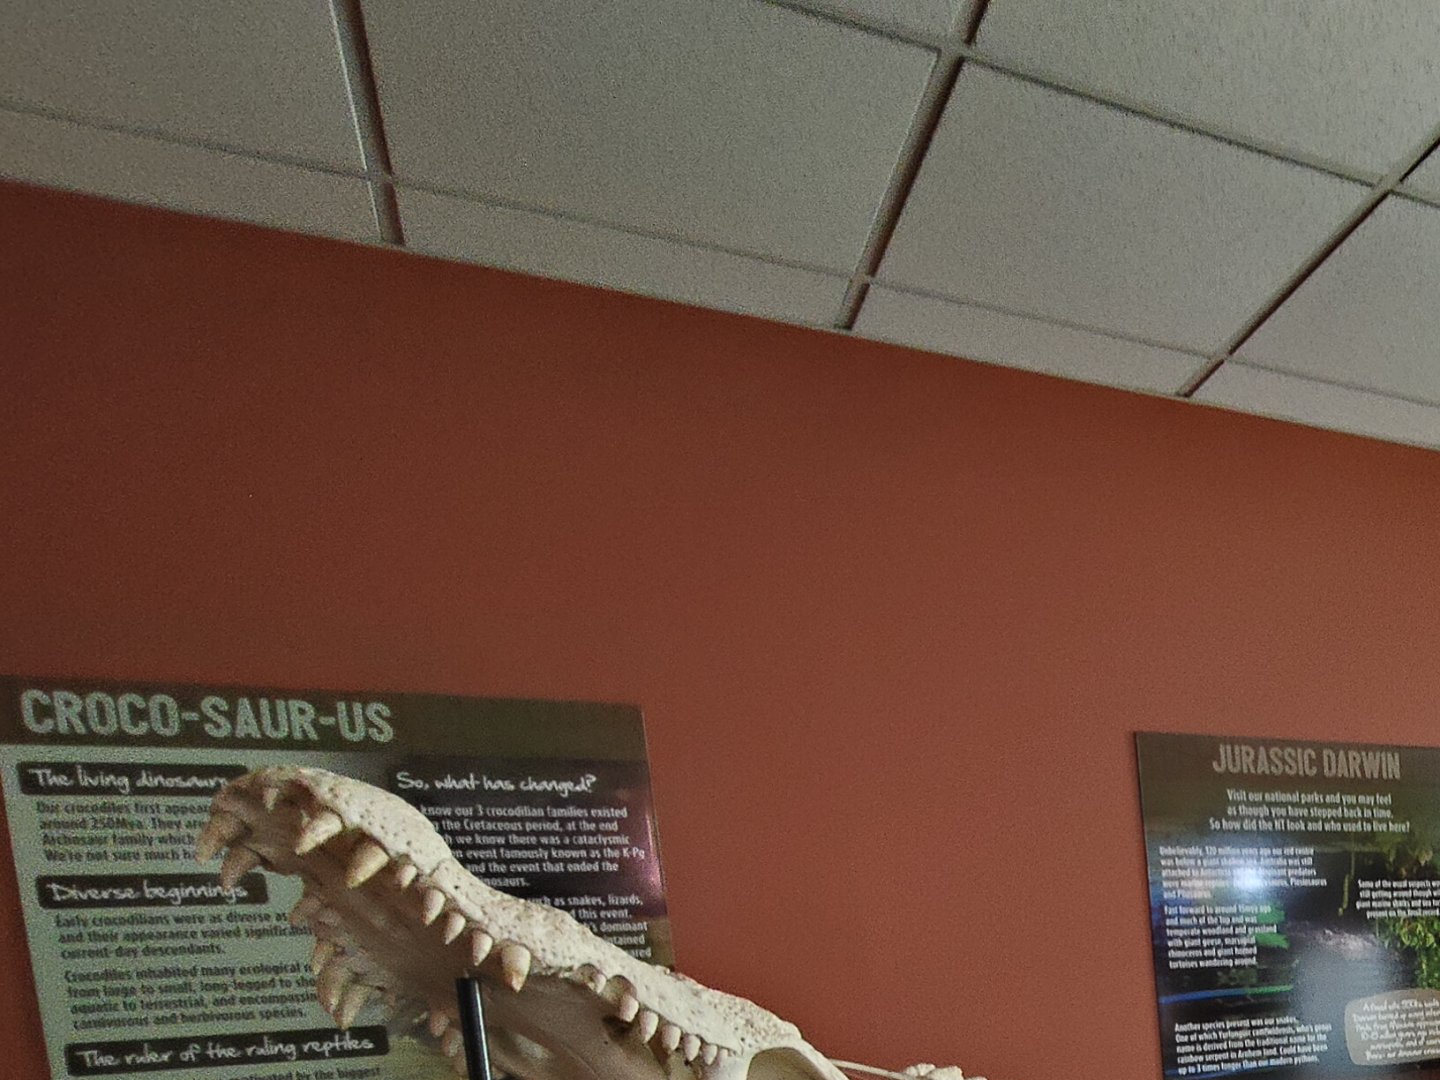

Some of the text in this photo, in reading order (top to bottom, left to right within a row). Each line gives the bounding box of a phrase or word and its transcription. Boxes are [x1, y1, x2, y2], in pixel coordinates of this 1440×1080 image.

[19, 690, 394, 742] CROCO-SAUR-US
[1211, 743, 1400, 779] JURASSIC DARWIN
[29, 768, 73, 786] The
[75, 765, 131, 794] living
[396, 772, 598, 797] So, what has changed?
[1226, 789, 1391, 805] Visit our national parks and you may feel
[420, 805, 627, 817] know our 3 crocodilian families existed
[1227, 803, 1237, 816] as
[1238, 804, 1269, 816] though
[1271, 804, 1286, 817] you
[1288, 805, 1307, 817] have
[1309, 805, 1341, 818] stepped
[1343, 806, 1362, 818] back
[1363, 806, 1371, 818] in
[441, 819, 618, 832] the Cretaceous period, at the end
[1209, 818, 1410, 832] So how did the NT look and who used to live here?
[455, 833, 629, 846] we know there was a cataclysmic
[466, 848, 497, 860] event
[499, 847, 548, 860] famously
[551, 847, 586, 859] known
[588, 847, 601, 859] as
[602, 847, 620, 859] the
[488, 863, 506, 873] the
[509, 862, 540, 873] event
[543, 862, 564, 872] that
[567, 861, 599, 872] ended
[601, 861, 619, 872] the
[46, 878, 248, 905] Diverse beginnings
[553, 894, 643, 906] as snakes, lizards,
[55, 914, 88, 929] Early
[91, 912, 170, 928] crocodilians
[172, 911, 204, 926] were
[208, 911, 223, 925] as
[225, 910, 271, 924] diverse
[578, 907, 631, 919] this event.
[599, 920, 647, 933] dominant
[58, 926, 240, 944] and their appearance varied
[63, 962, 300, 983] Crocodiles inhabited many ecological
[67, 986, 99, 1000] from
[103, 984, 137, 999] large
[141, 984, 155, 997] to
[279, 979, 292, 992] to
[75, 1030, 375, 1067] The ruler of the ruling reptiles
[313, 1068, 334, 1080] the
[337, 1065, 380, 1080] biggest
